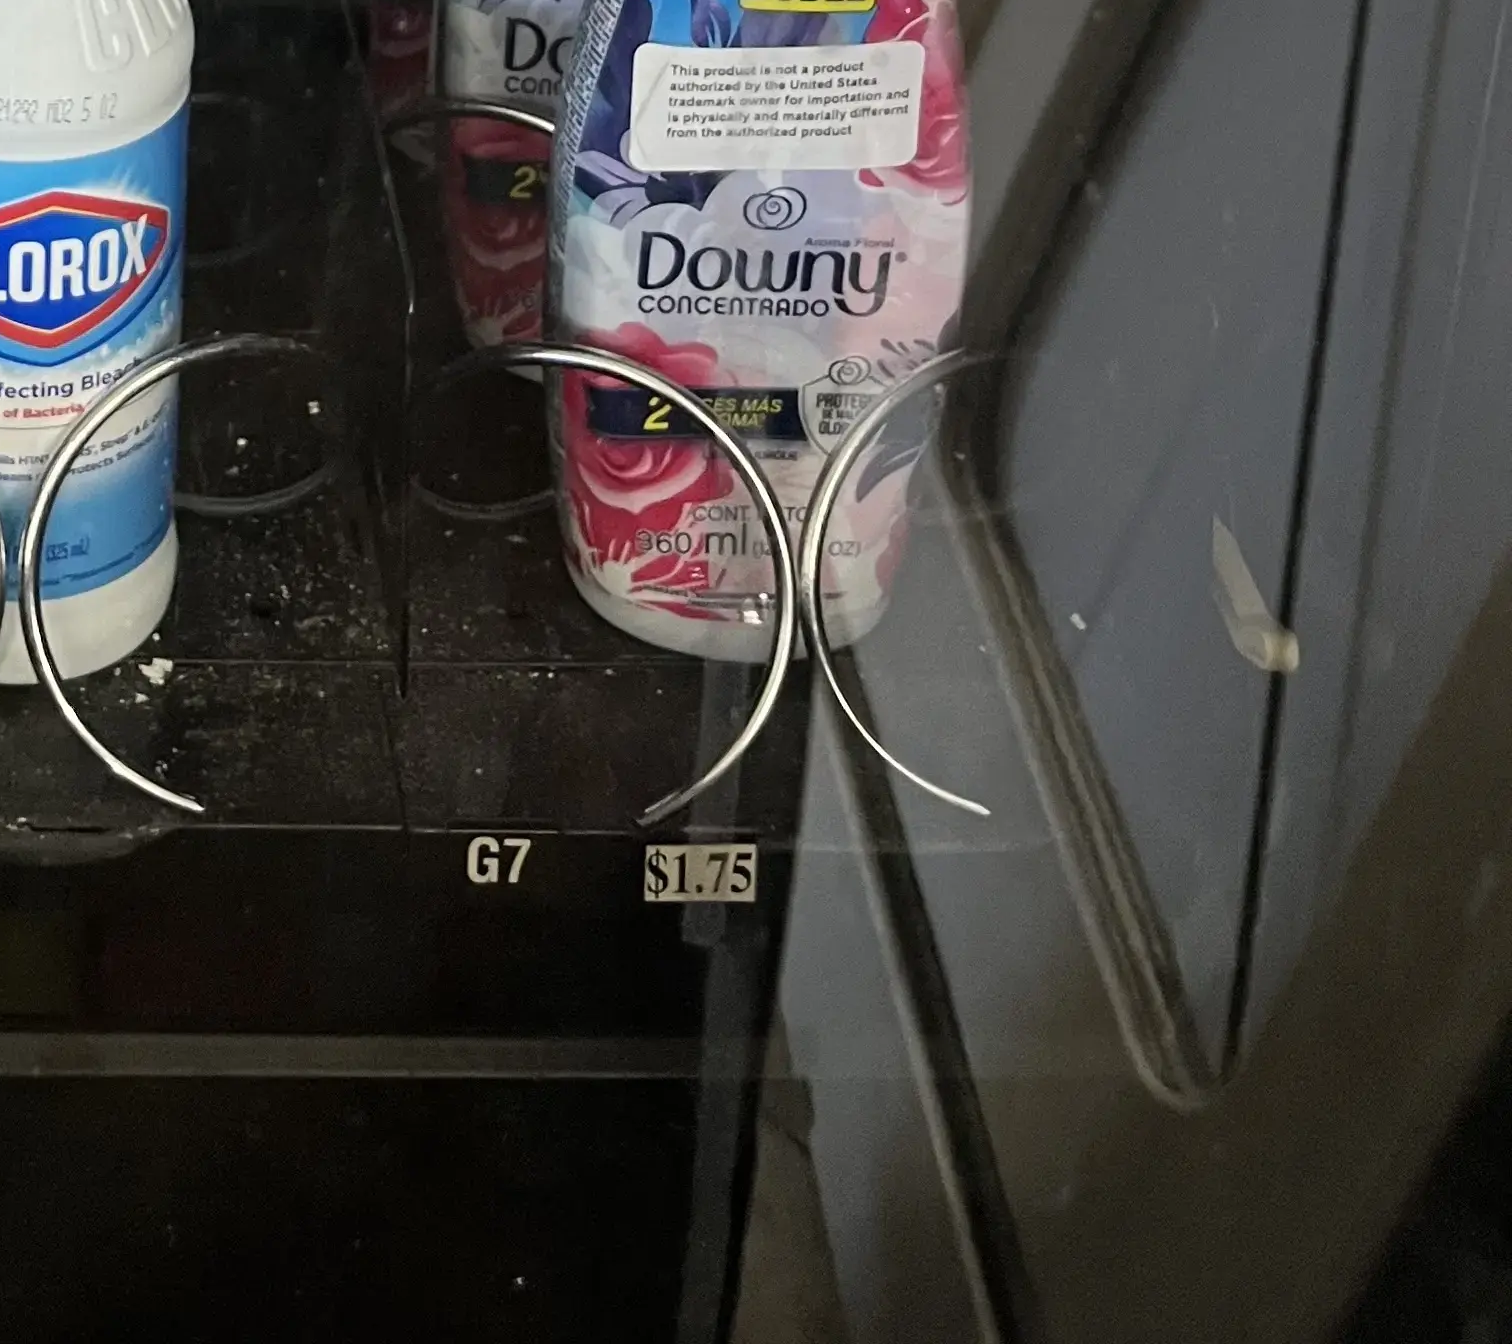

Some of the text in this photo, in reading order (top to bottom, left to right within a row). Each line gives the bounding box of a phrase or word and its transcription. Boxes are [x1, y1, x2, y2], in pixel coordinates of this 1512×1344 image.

[670, 61, 865, 79] This product is not a product
[669, 76, 878, 94] authorized by the United States
[668, 88, 910, 107] trademark owner for importation and
[667, 109, 847, 126] is physically and materially
[666, 124, 853, 139] from the authorized product
[637, 230, 893, 318] Downy
[637, 295, 831, 318] CONCENTRADO
[2, 406, 18, 419] of
[739, 395, 784, 413] MÁS
[643, 397, 675, 432] 2
[692, 505, 751, 522] CONT.
[636, 529, 692, 554] 360
[705, 523, 747, 554] ml
[466, 836, 532, 884] G7
[646, 848, 754, 899] $1.75
